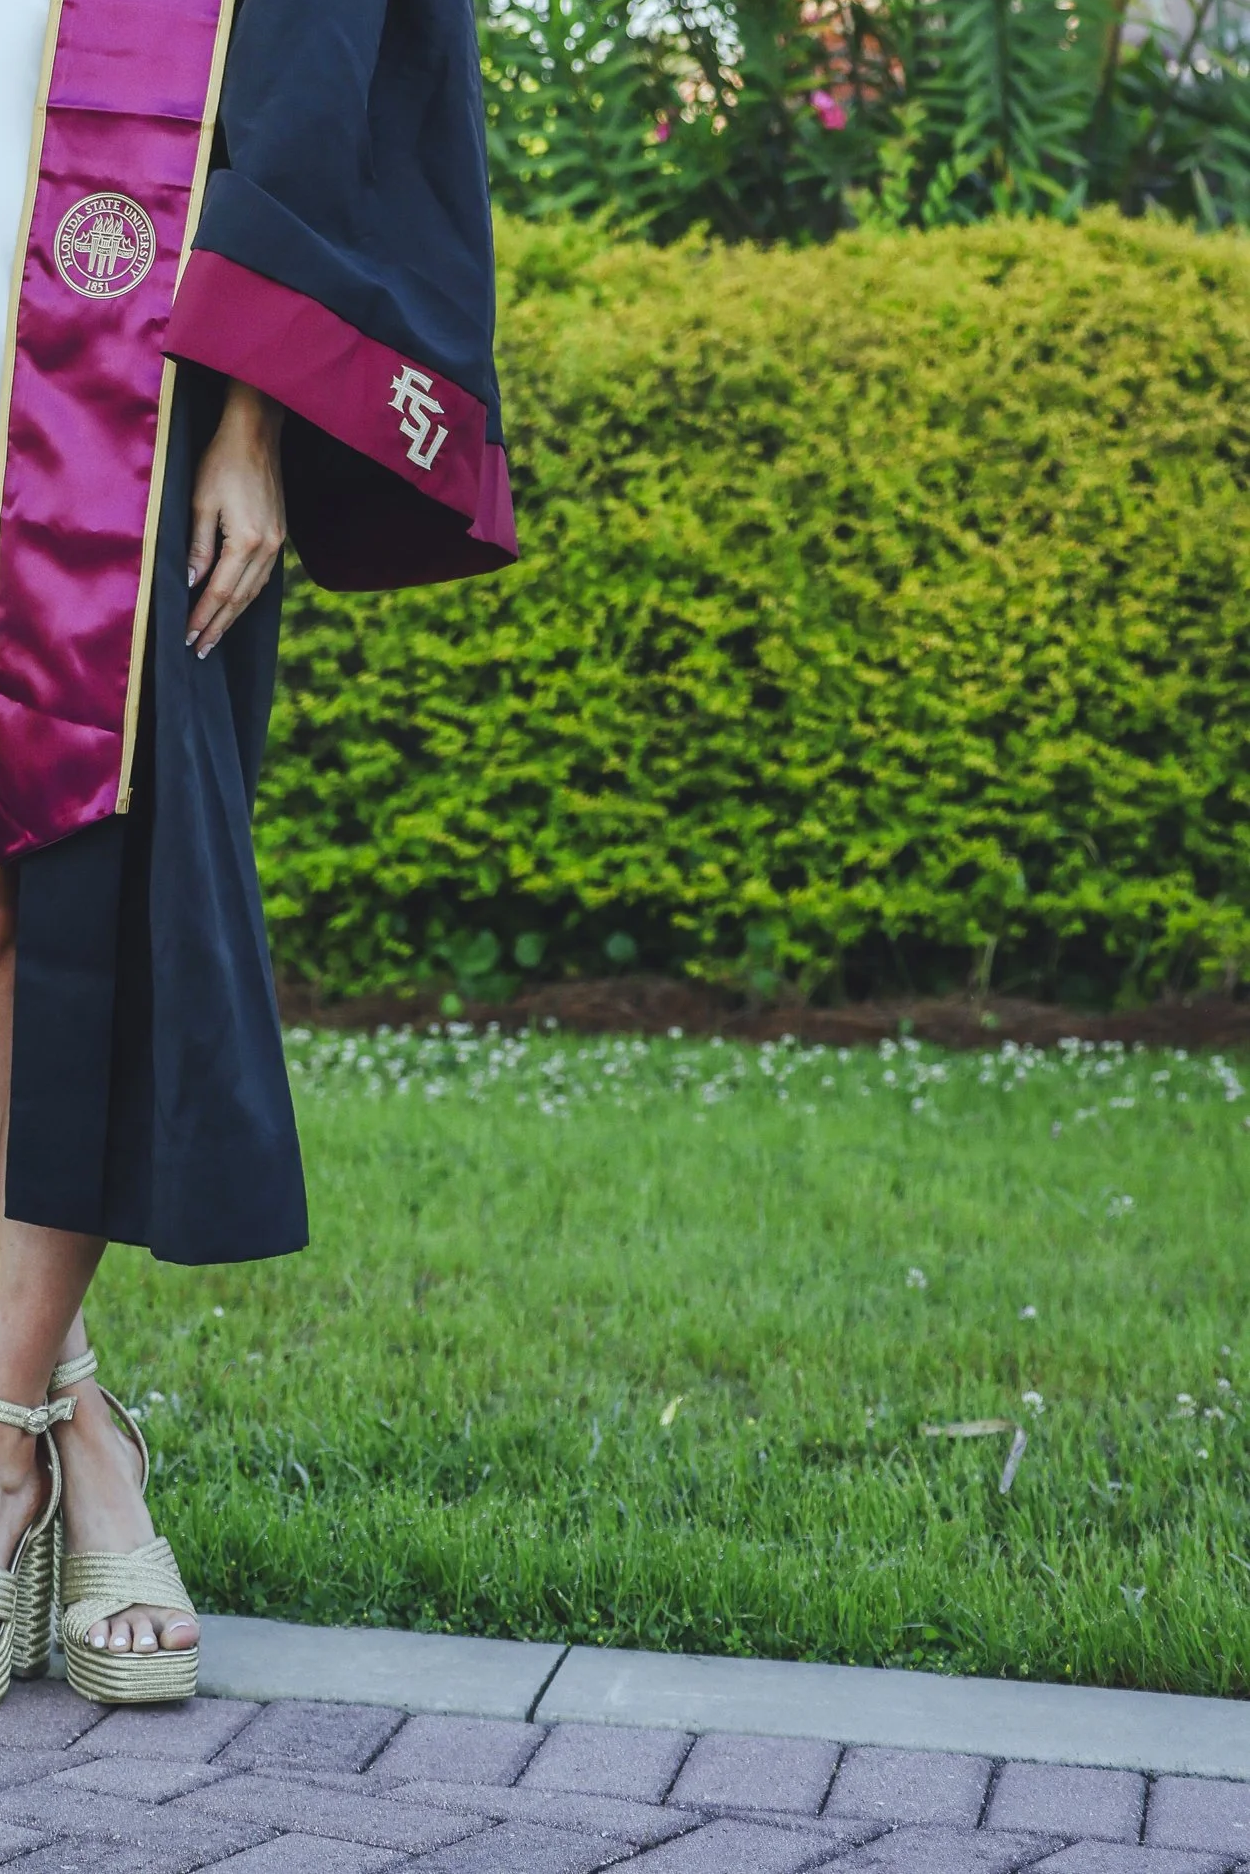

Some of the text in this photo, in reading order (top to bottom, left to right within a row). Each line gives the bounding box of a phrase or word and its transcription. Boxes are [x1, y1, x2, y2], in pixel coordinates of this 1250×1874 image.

[61, 199, 149, 278] FLORIDA STATE UNIVERSITY
[85, 280, 109, 293] 1851
[387, 364, 449, 471] FSU
